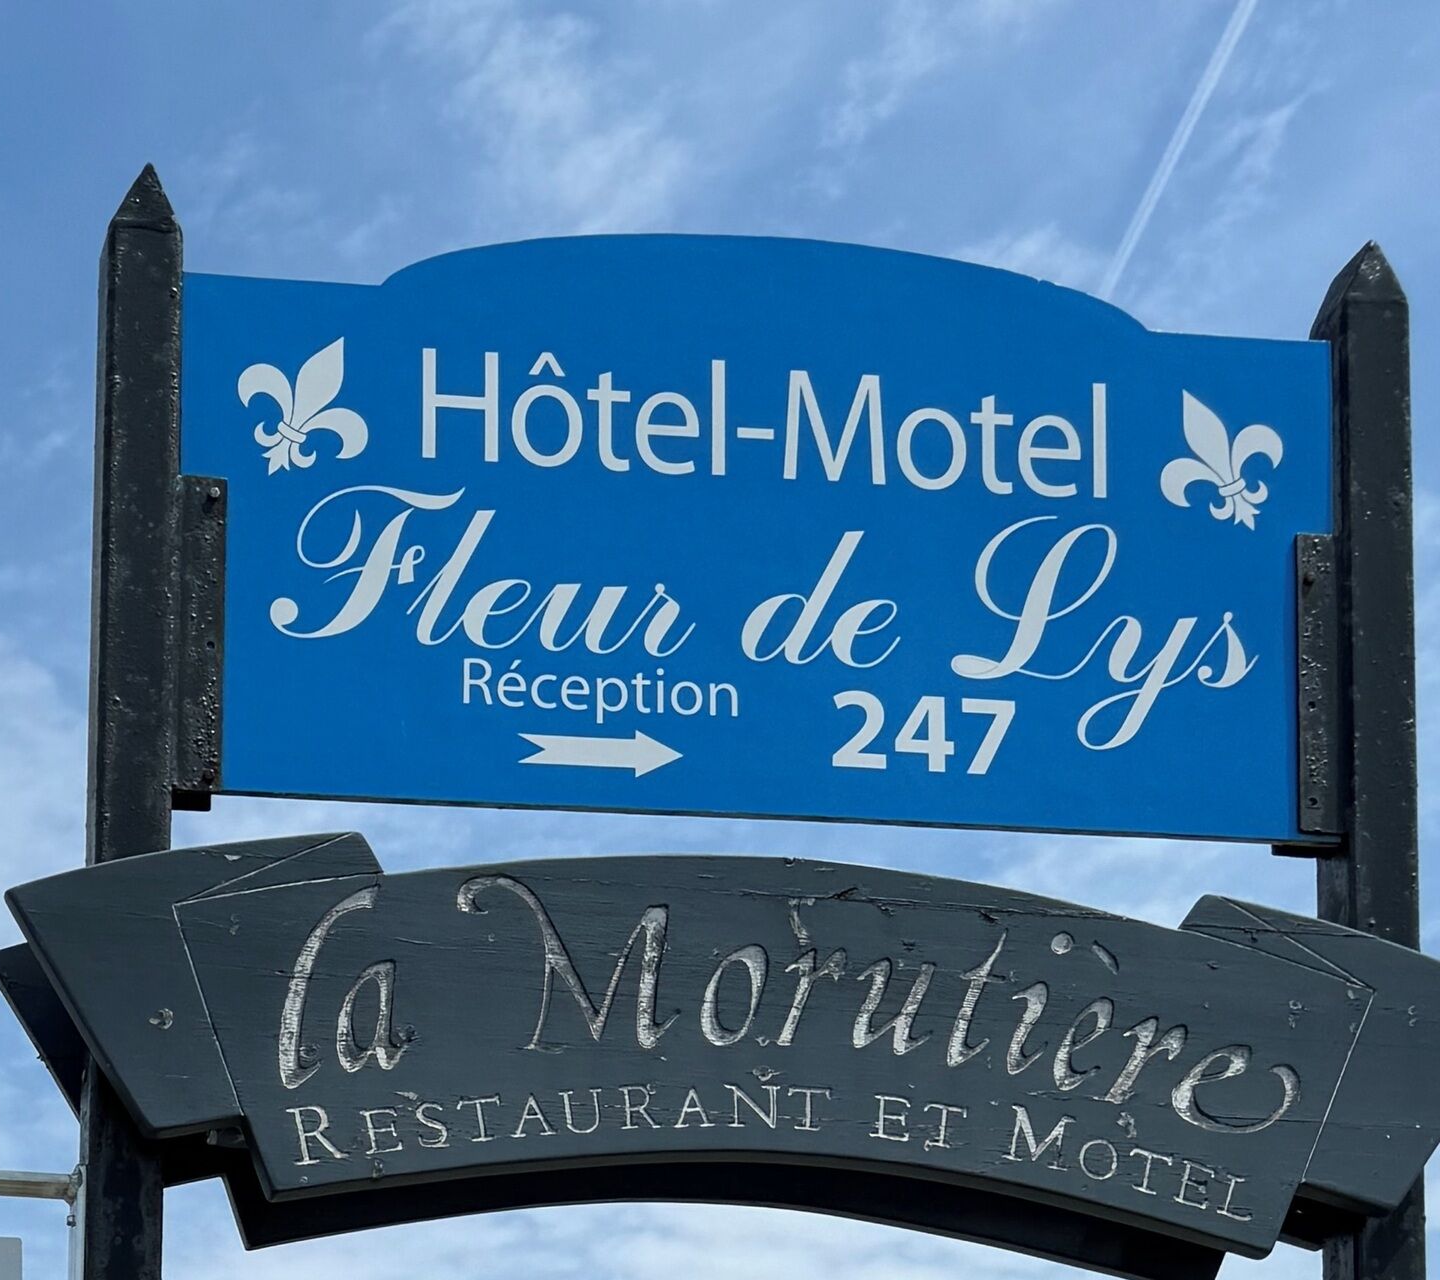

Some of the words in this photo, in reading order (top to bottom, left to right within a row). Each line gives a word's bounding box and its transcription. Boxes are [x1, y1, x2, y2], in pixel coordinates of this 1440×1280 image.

[422, 347, 1107, 499] Hôtel-Motel
[269, 485, 696, 657] Fleur
[741, 530, 901, 668] de
[950, 515, 1258, 750] Lys
[463, 656, 739, 724] Réception
[832, 690, 1016, 775] 247
[456, 873, 1301, 1134] Morutière
[285, 1082, 831, 1165] RESTAURANT
[869, 1094, 968, 1152] ET
